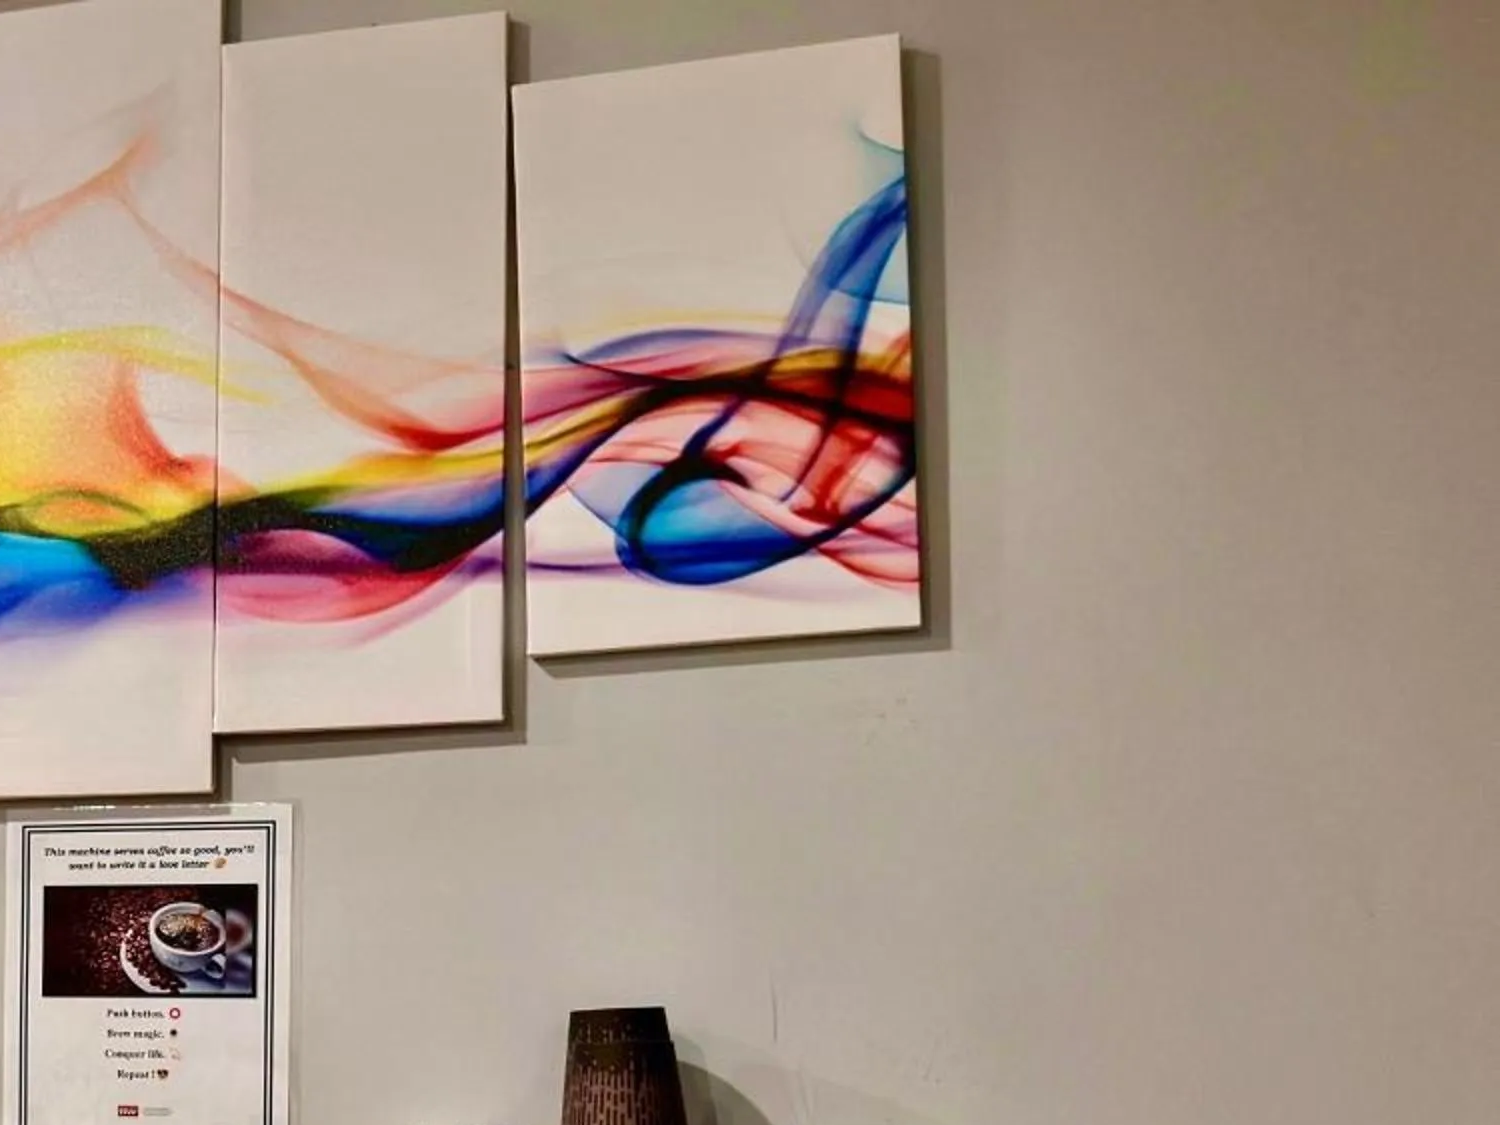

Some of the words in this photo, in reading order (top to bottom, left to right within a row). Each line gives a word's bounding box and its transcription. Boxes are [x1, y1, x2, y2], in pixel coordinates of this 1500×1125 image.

[44, 848, 65, 856] This
[68, 847, 110, 856] machine
[147, 845, 177, 857] coffee
[159, 860, 179, 869] love
[106, 1008, 129, 1018] Push
[106, 1029, 131, 1038] Brew
[104, 1049, 145, 1061] Conquer
